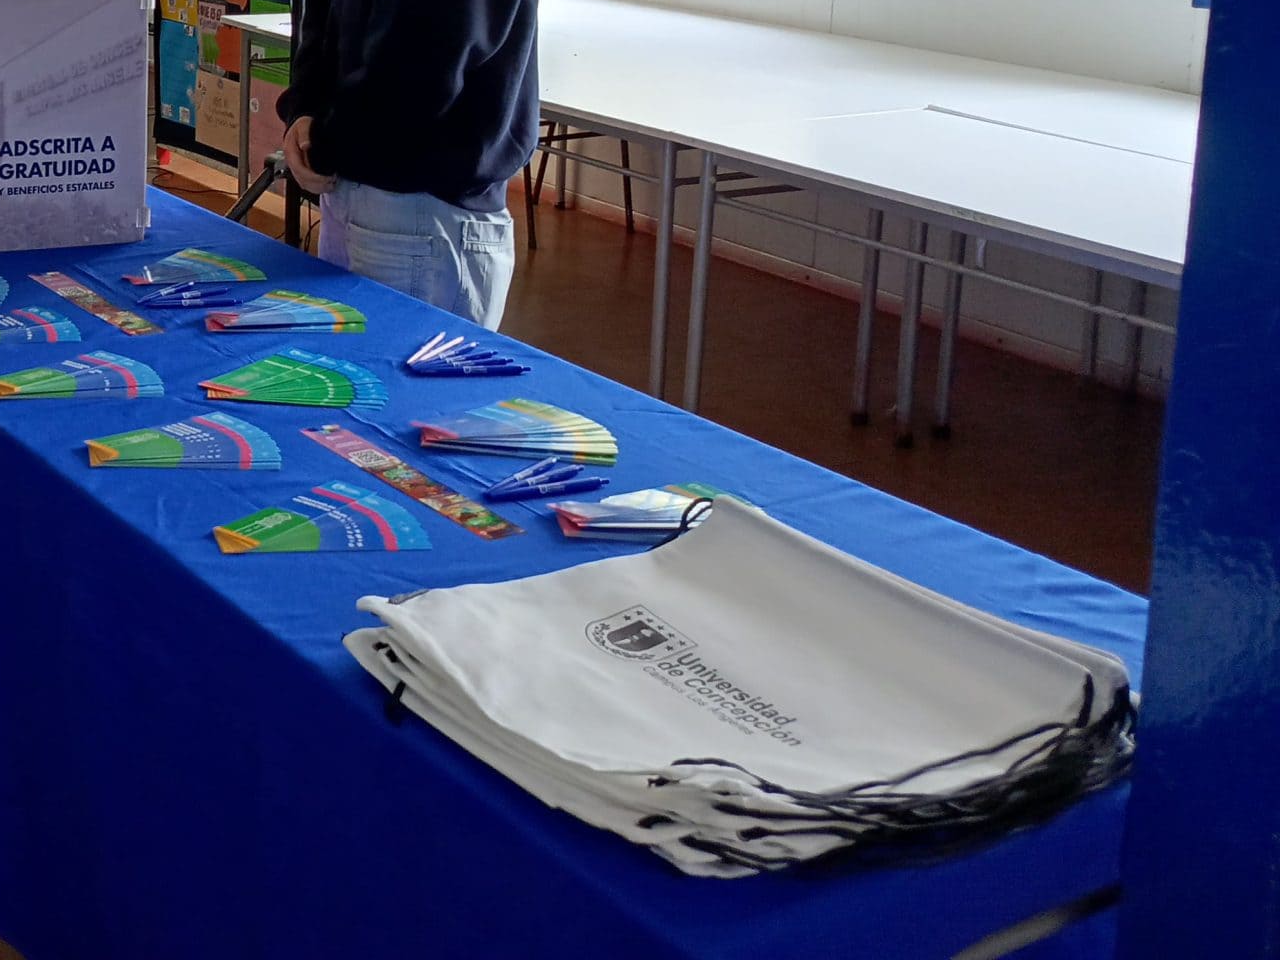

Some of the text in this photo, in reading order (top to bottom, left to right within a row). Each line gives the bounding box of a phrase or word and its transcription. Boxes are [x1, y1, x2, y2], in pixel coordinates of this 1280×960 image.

[101, 135, 116, 151] A
[7, 184, 64, 196] BENEFICIOS
[66, 181, 115, 193] ESTATALES
[658, 661, 801, 747] de Concepción
[677, 652, 797, 726] Universidad
